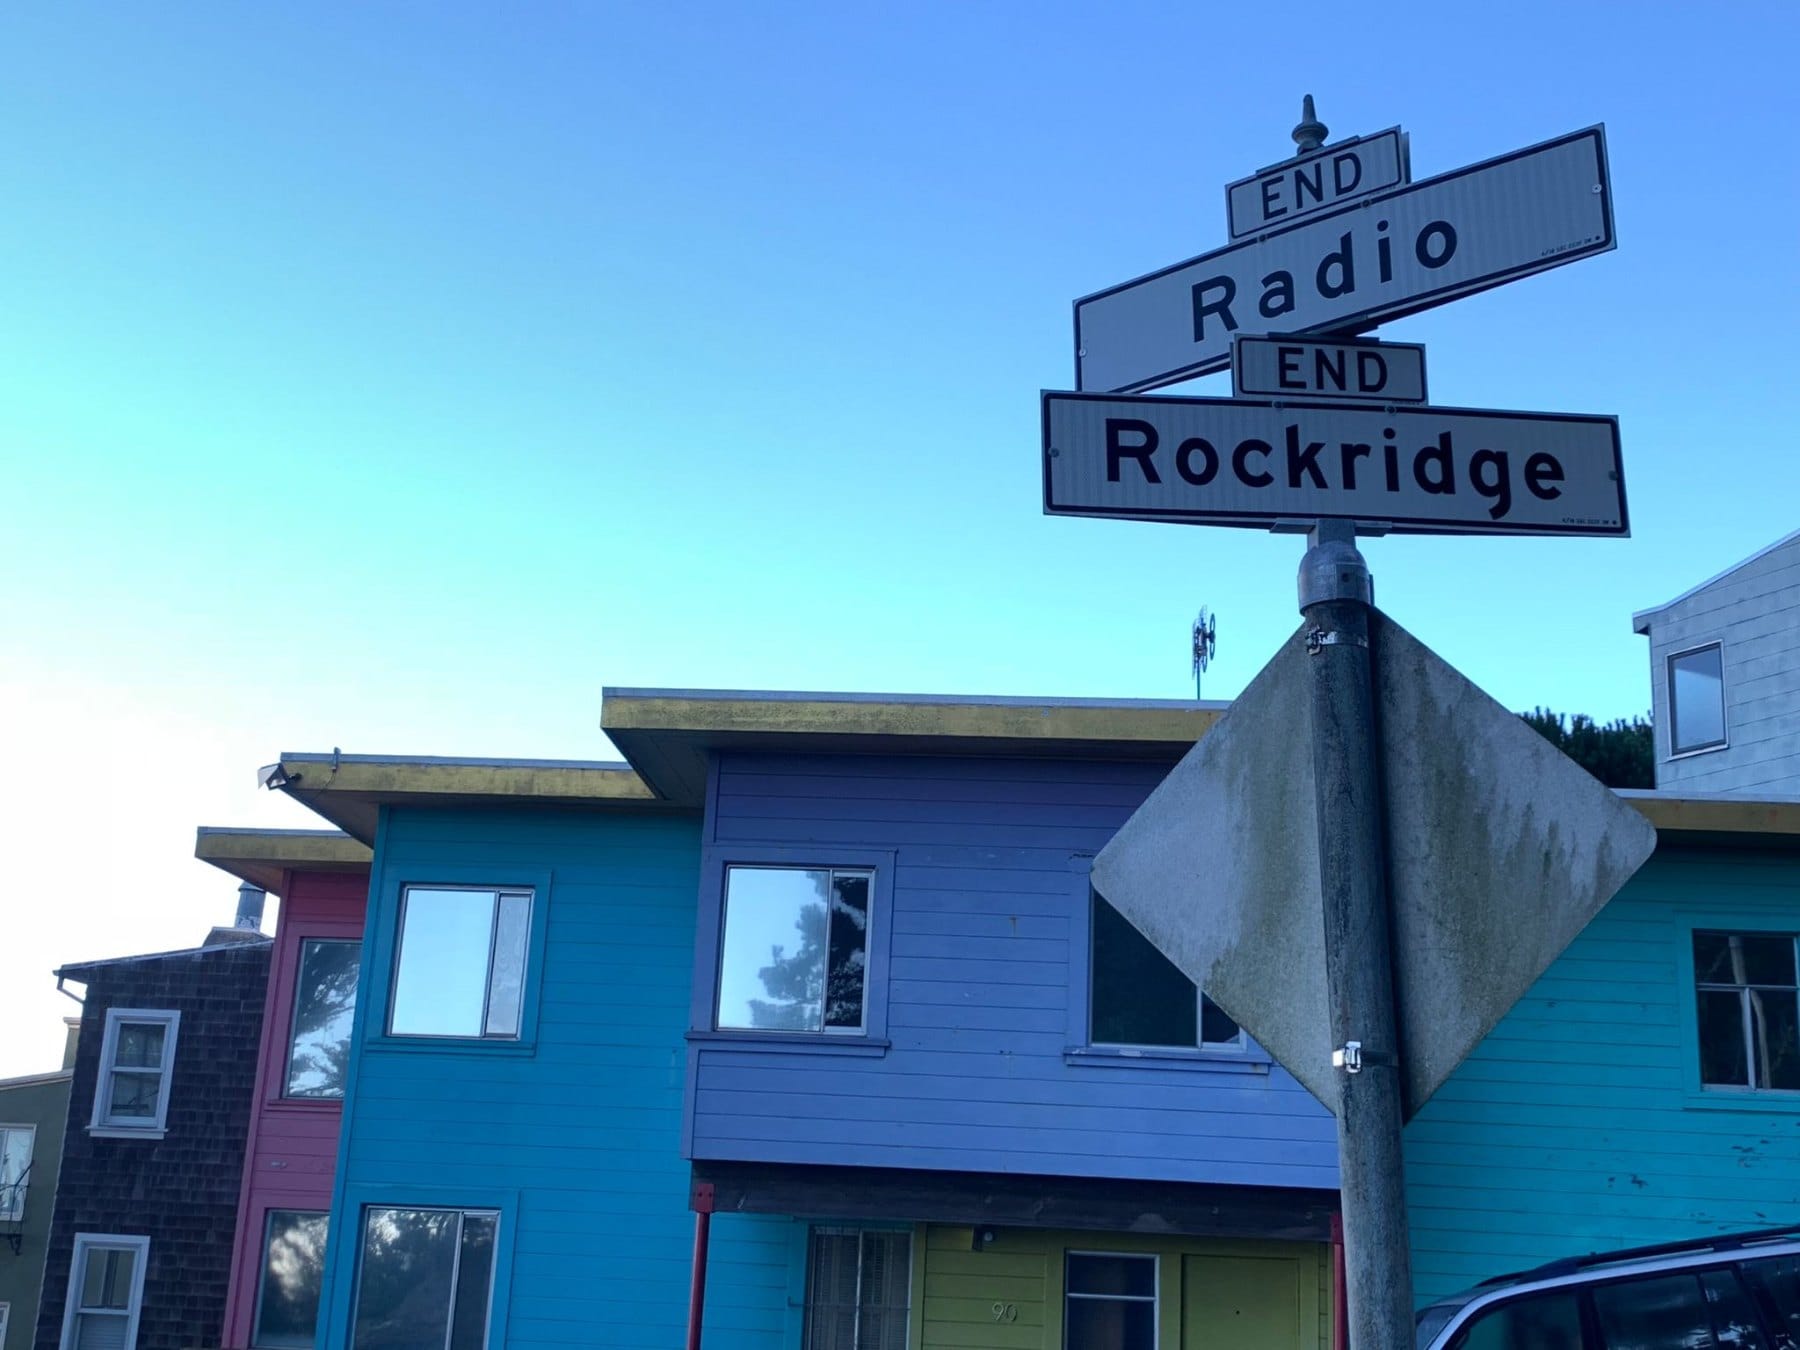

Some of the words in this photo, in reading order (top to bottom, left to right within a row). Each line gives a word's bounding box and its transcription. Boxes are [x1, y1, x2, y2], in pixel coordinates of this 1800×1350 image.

[1261, 152, 1362, 221] END
[1191, 220, 1458, 342] Radio
[1278, 346, 1388, 393] END
[1105, 418, 1565, 520] Rockridge
[992, 1302, 1017, 1322] 90
